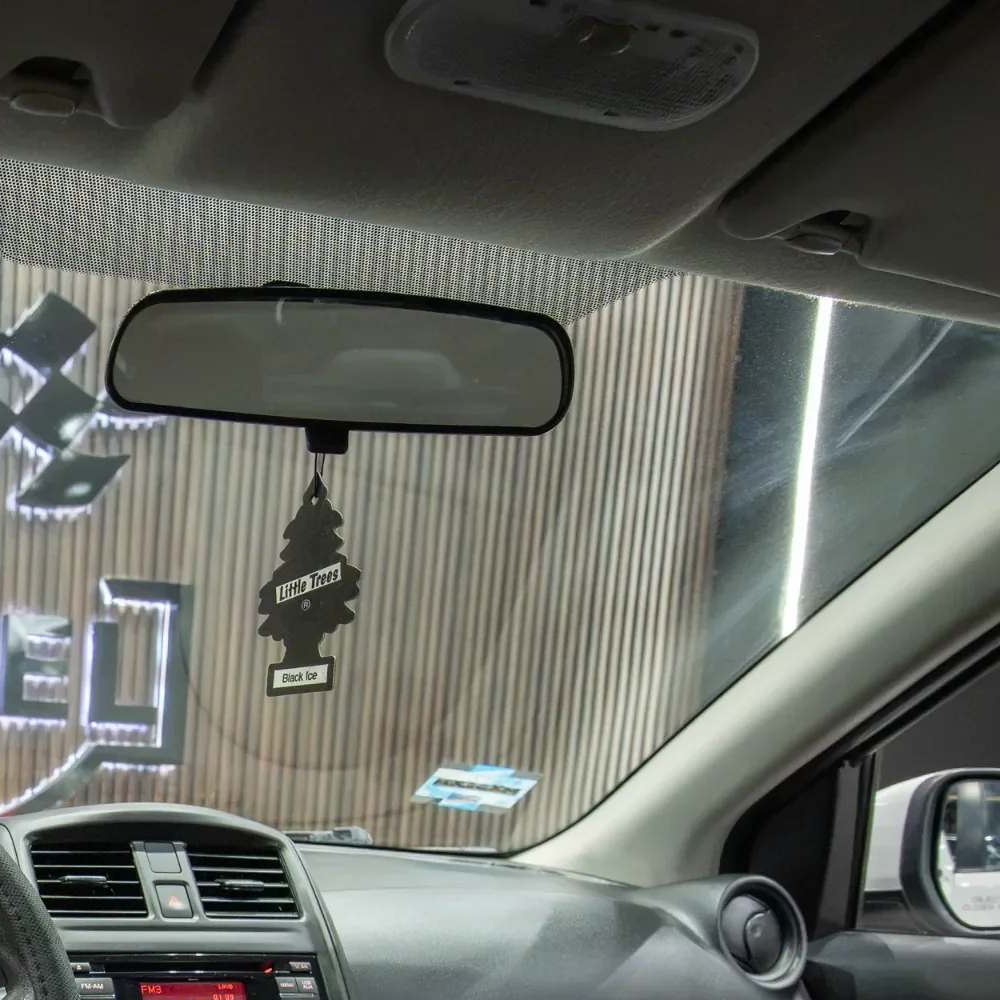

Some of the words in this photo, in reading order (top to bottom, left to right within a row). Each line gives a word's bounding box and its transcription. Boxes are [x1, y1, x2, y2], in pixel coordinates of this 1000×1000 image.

[279, 579, 306, 601] Little
[309, 569, 339, 589] Trees
[282, 672, 303, 683] Black
[305, 671, 318, 681] Ice
[141, 984, 162, 994] FM3
